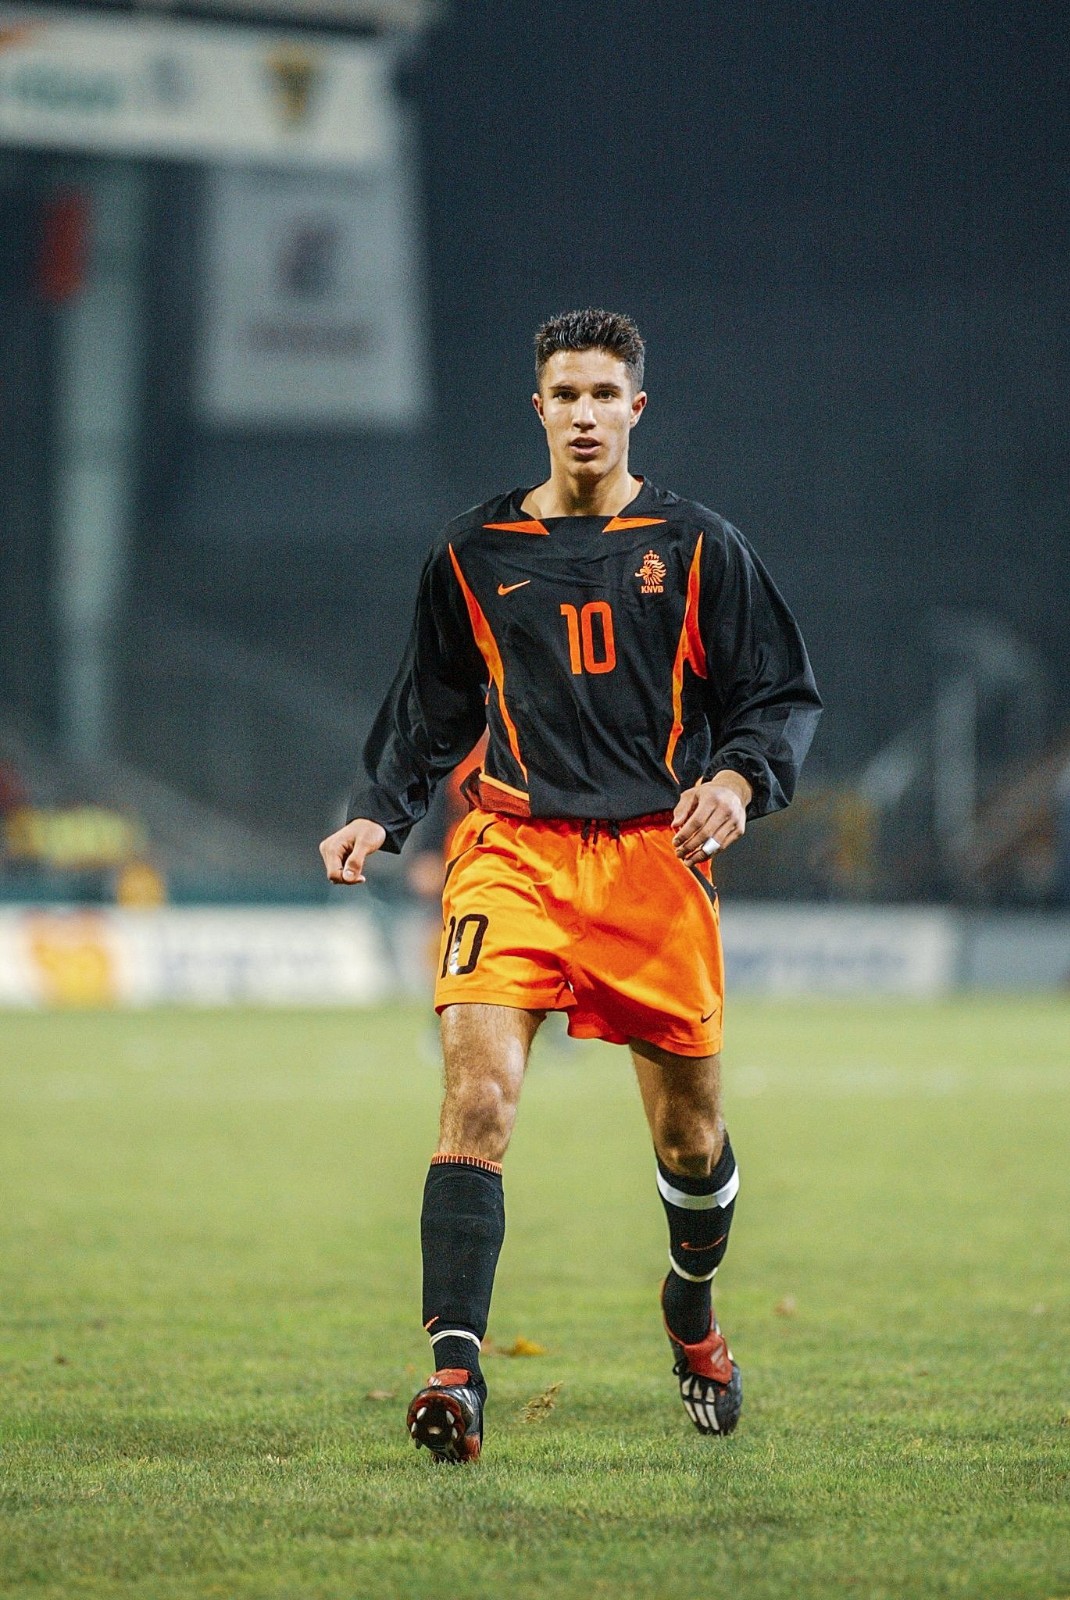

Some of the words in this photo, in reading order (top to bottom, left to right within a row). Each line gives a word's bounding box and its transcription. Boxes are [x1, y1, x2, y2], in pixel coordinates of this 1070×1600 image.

[641, 585, 664, 594] KNVB
[560, 601, 616, 675] 10
[441, 914, 489, 979] 10
